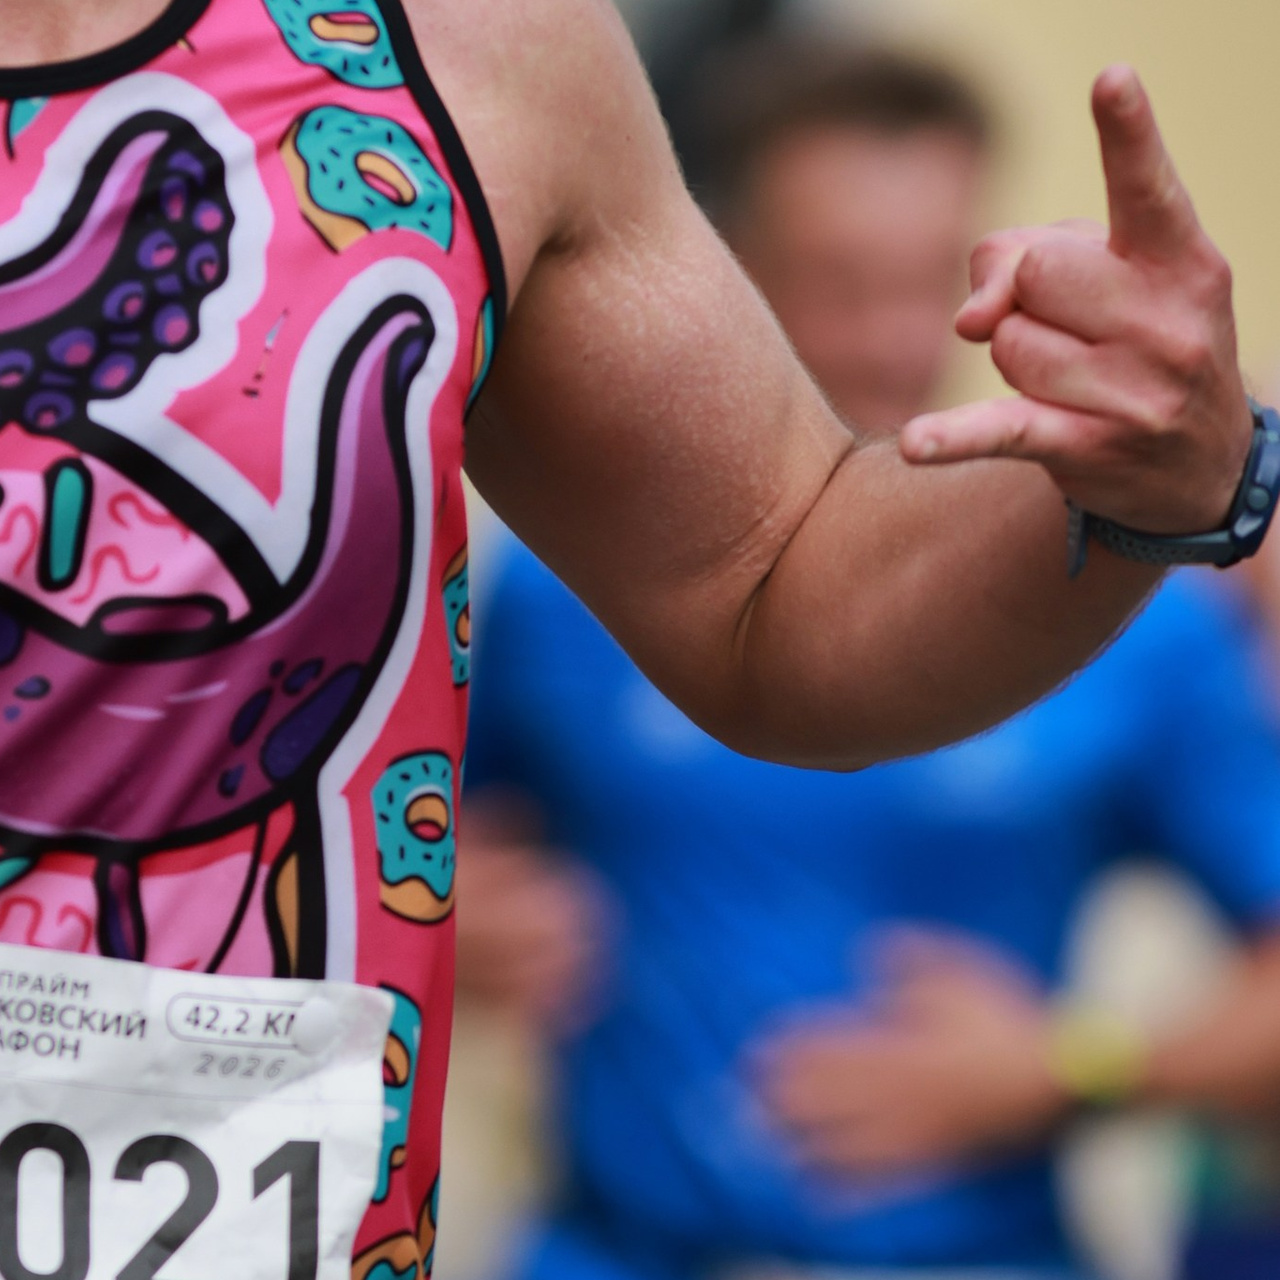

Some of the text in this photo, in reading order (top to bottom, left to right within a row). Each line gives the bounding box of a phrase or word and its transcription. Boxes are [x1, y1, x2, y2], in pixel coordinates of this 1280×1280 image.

[185, 1005, 296, 1037] 42,2 К
[194, 1051, 286, 1080] 2026
